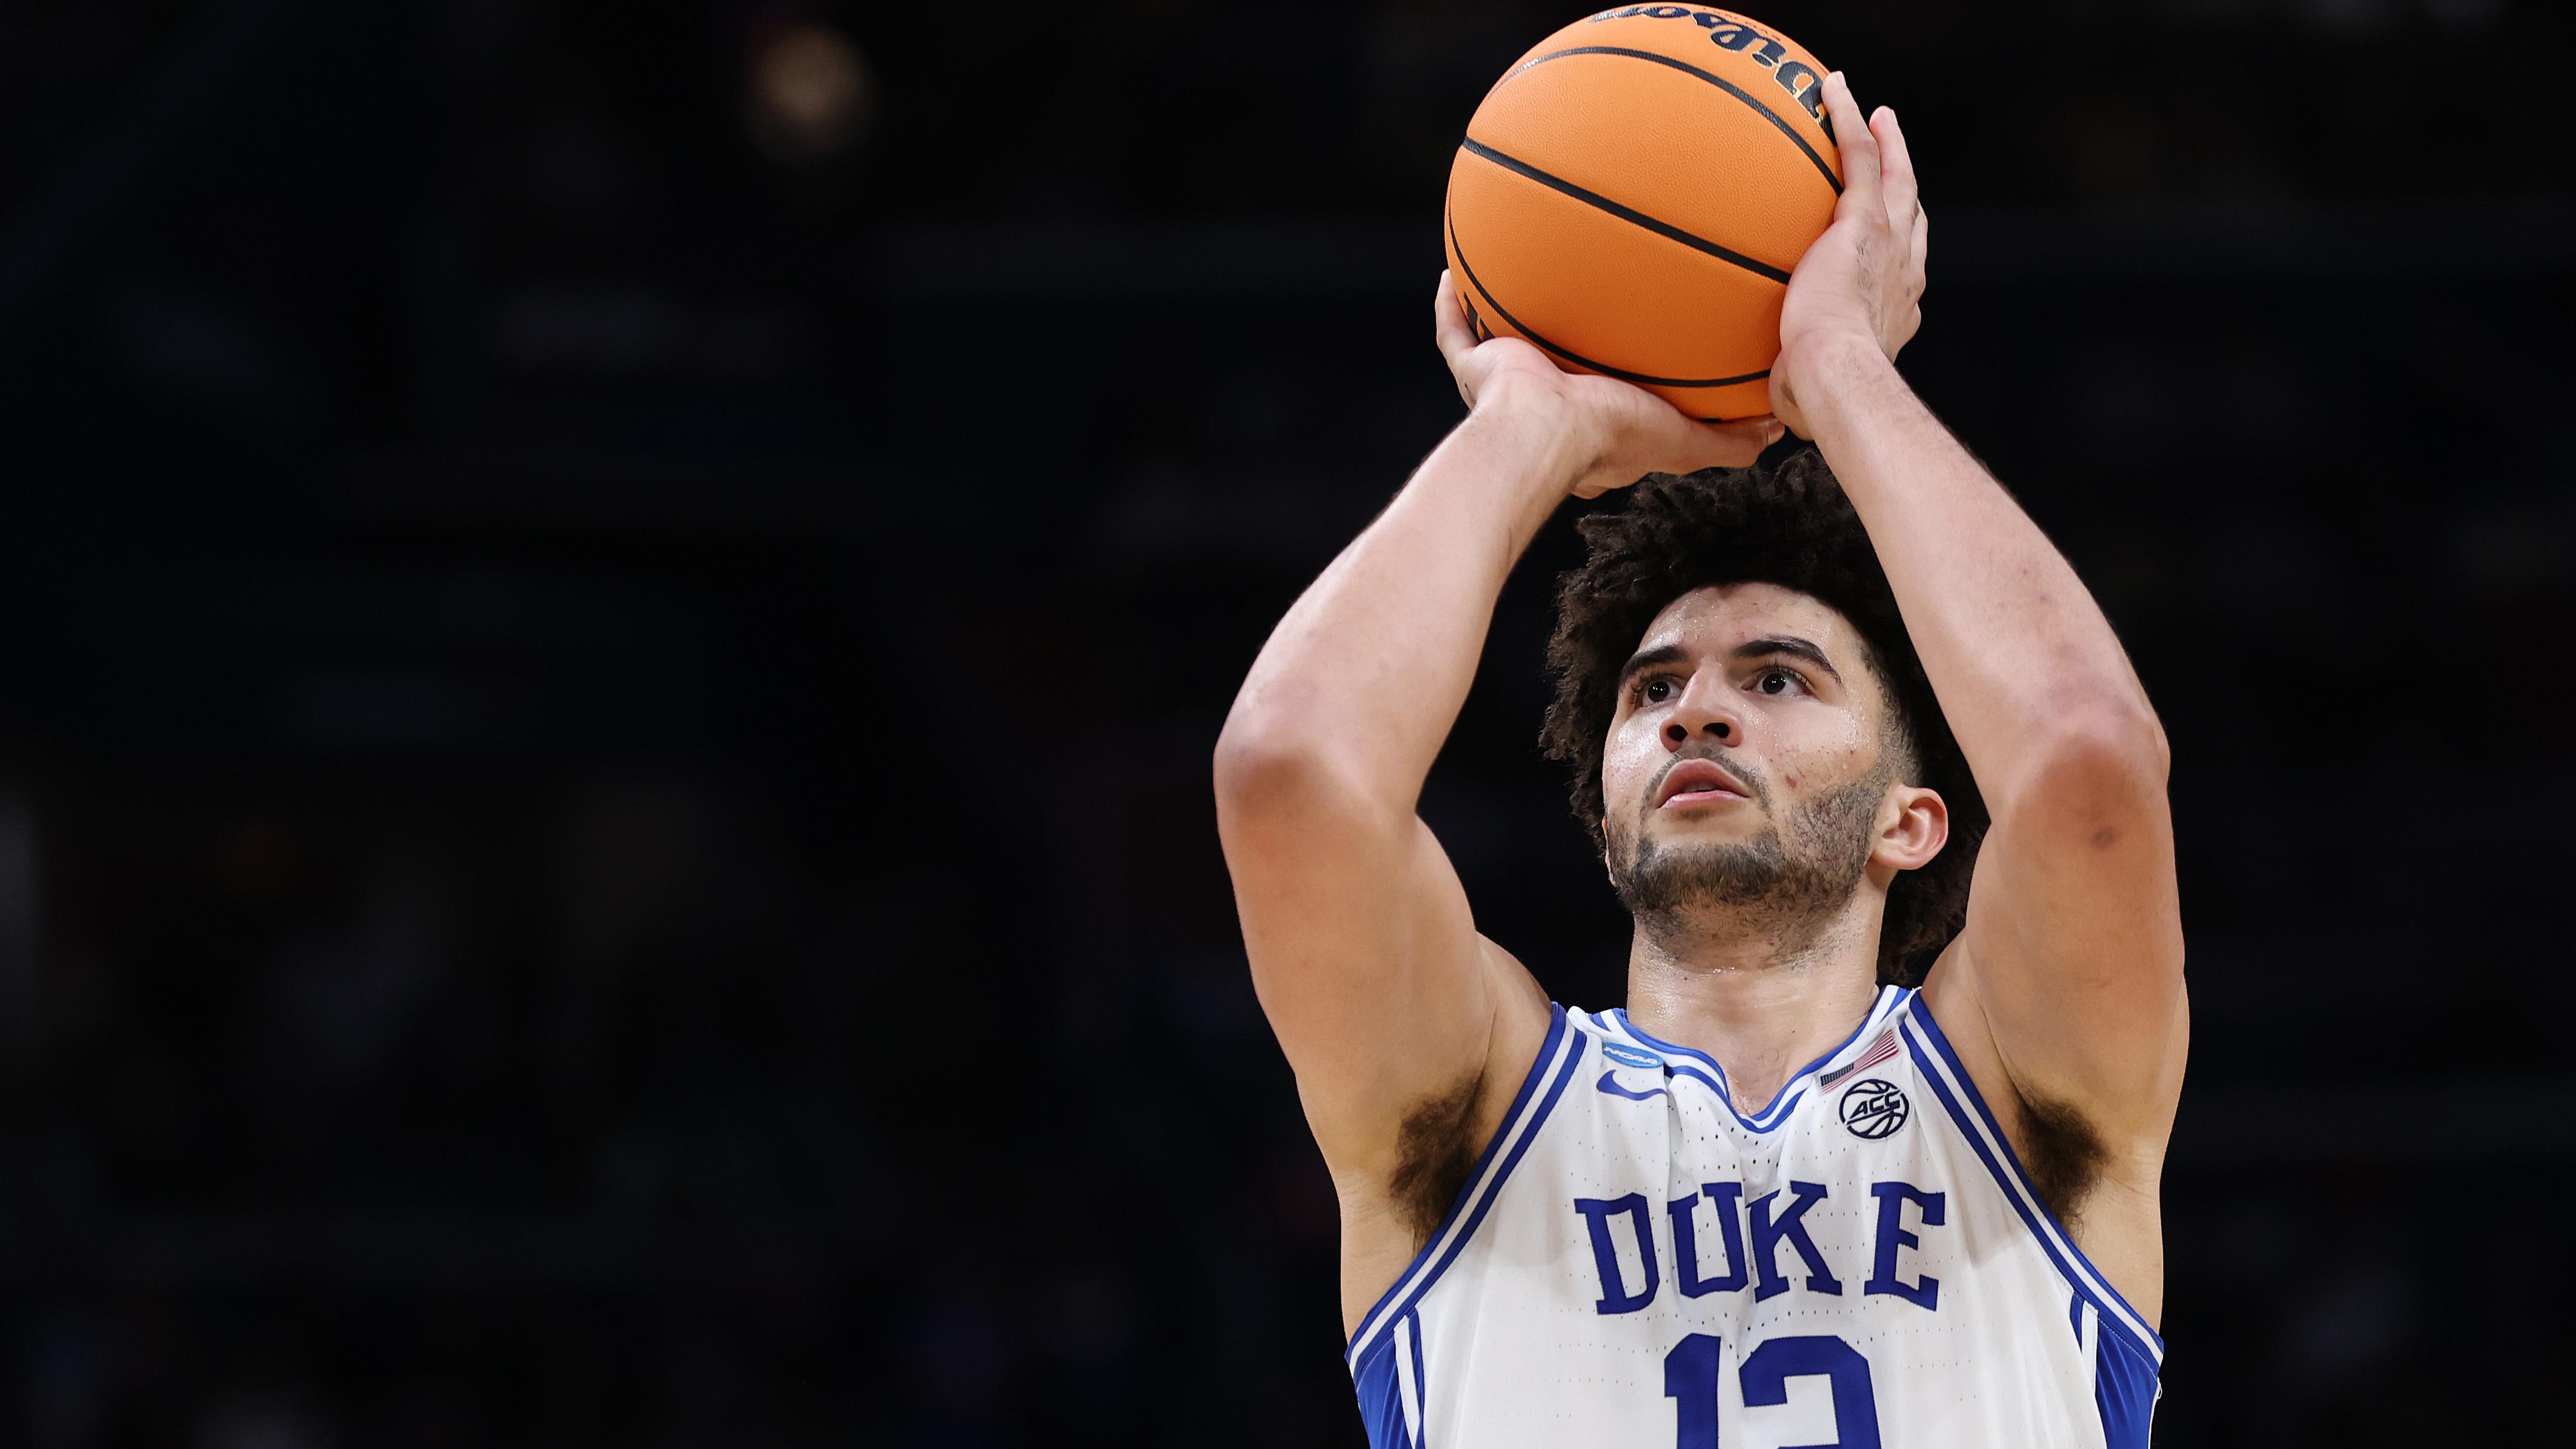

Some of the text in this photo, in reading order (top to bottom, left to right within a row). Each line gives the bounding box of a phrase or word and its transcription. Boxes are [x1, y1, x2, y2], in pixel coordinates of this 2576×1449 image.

[1603, 1046, 1658, 1064] NCAA
[1850, 1090, 1900, 1119] ACC
[1574, 1181, 1945, 1315] DUKE
